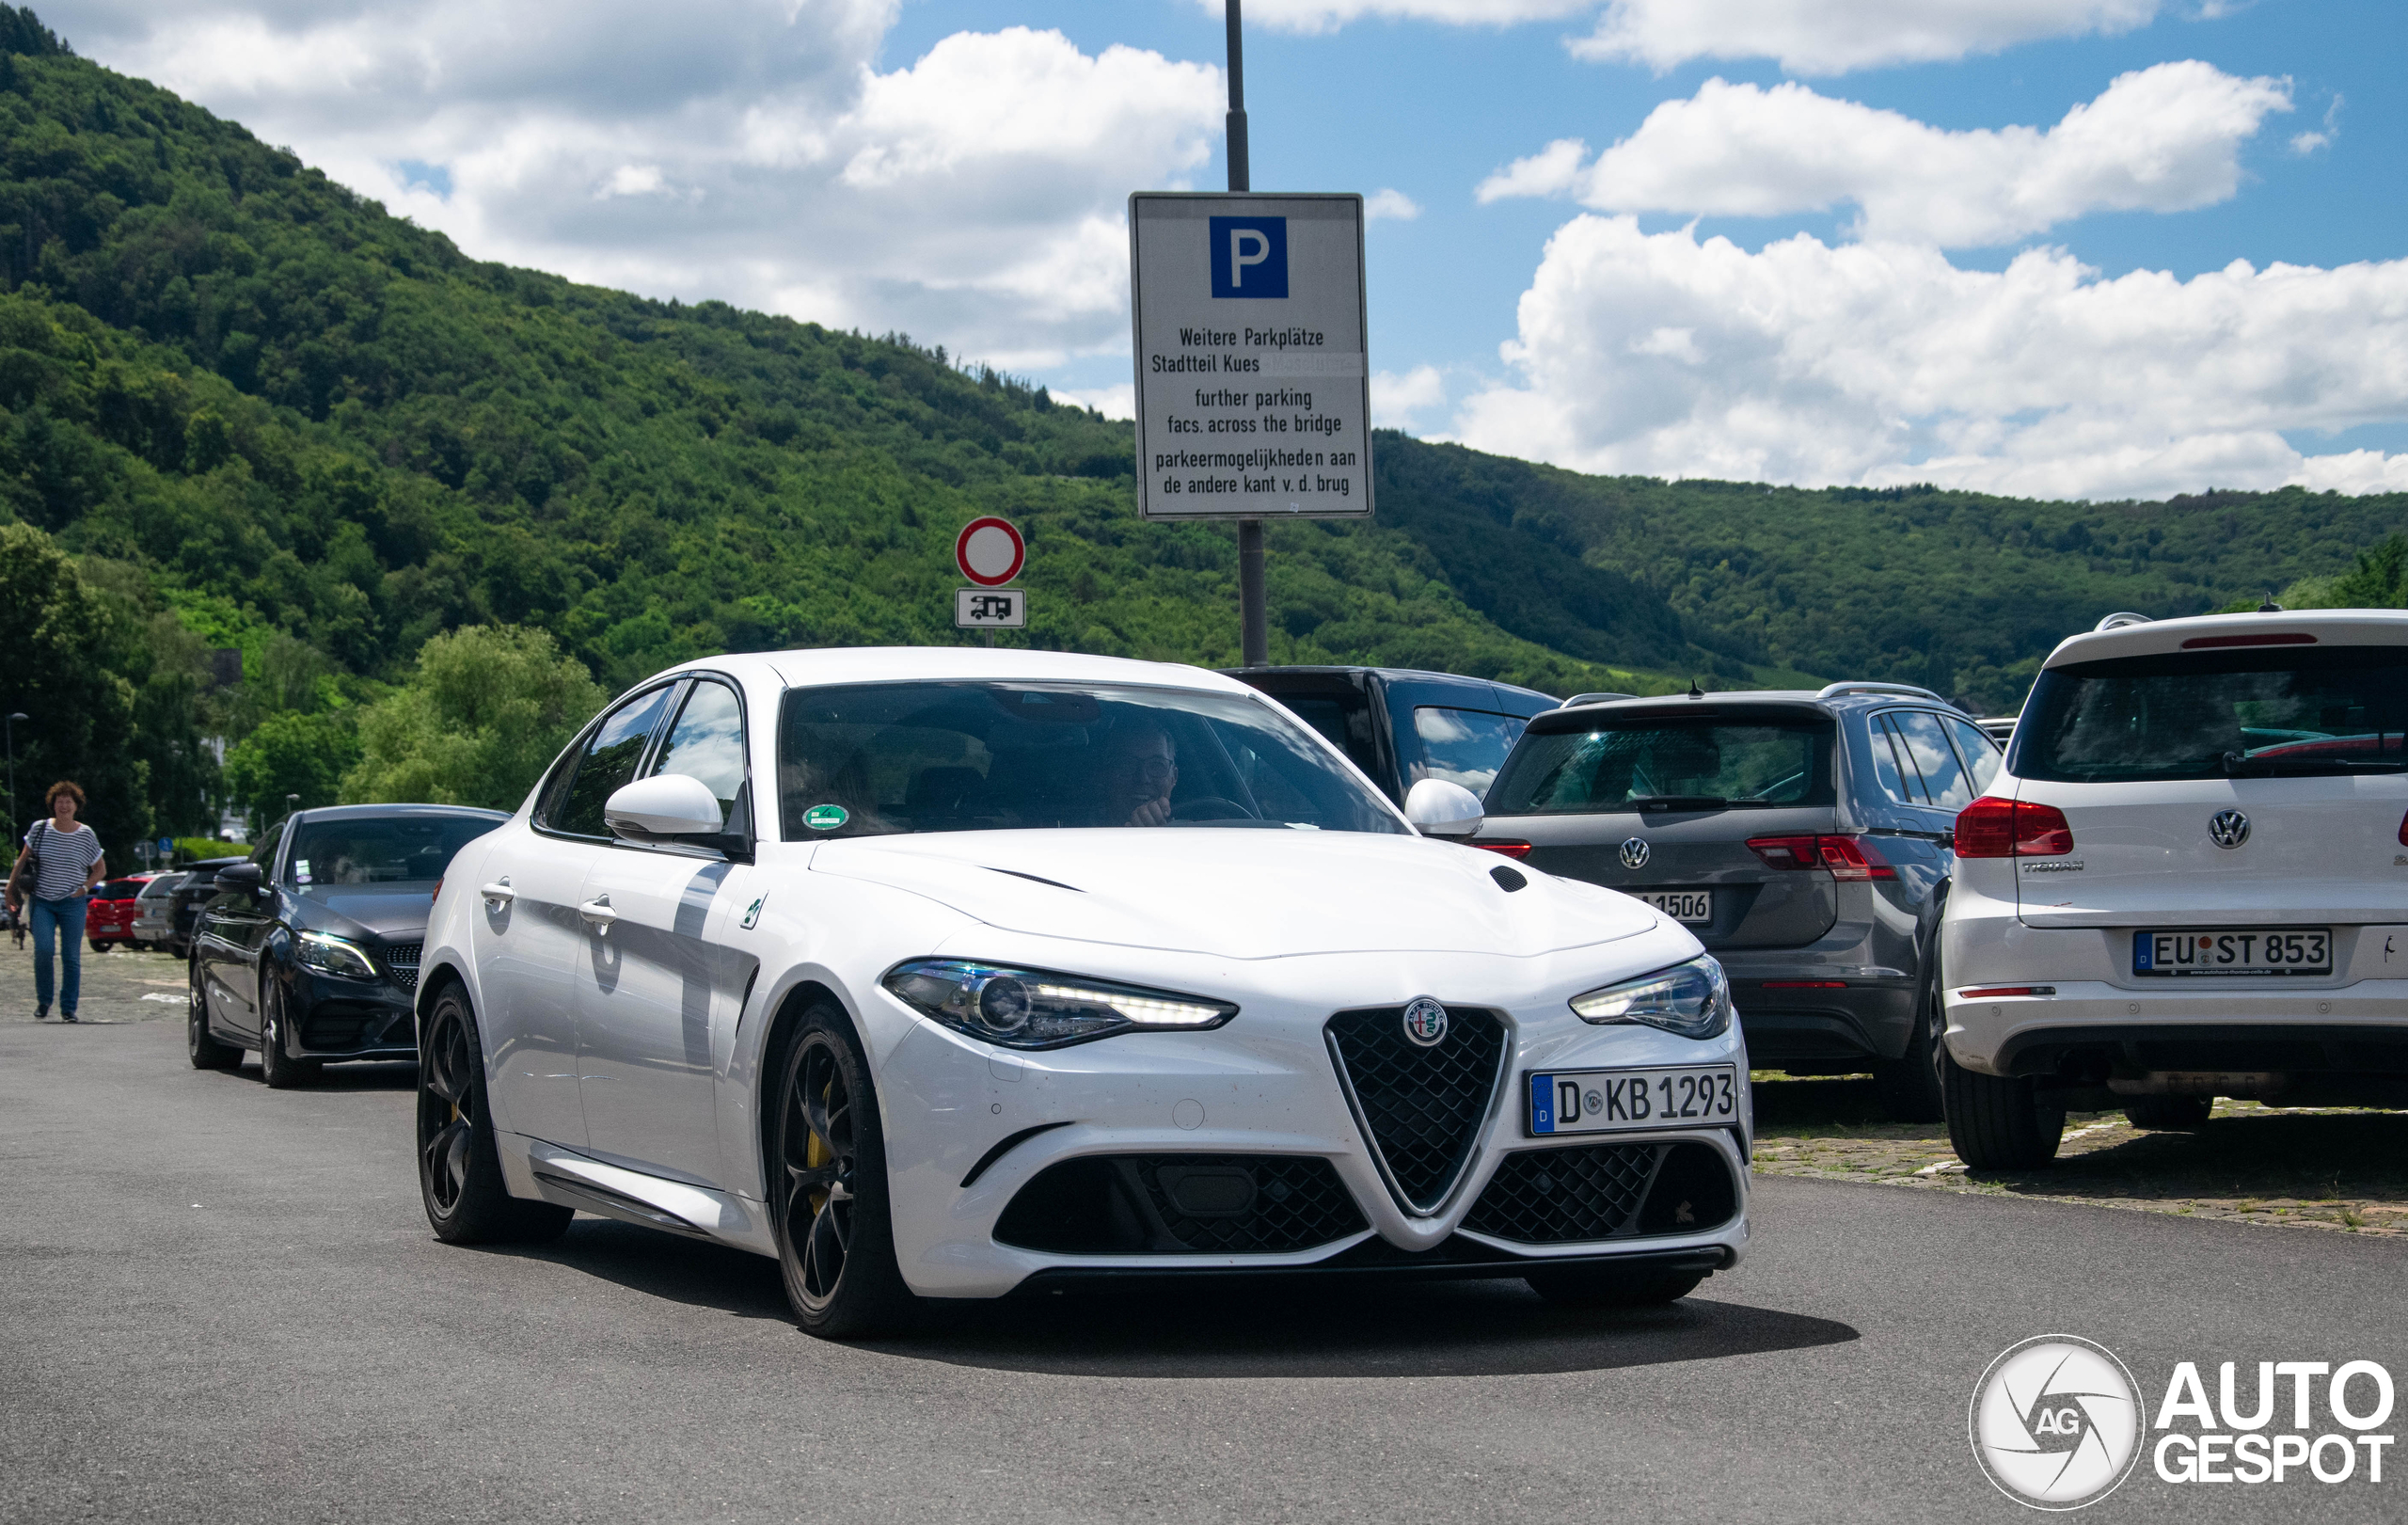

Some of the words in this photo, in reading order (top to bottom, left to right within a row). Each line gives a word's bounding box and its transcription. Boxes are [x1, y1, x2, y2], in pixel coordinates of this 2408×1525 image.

[1230, 229, 1270, 288] P
[1180, 327, 1237, 346] Weitere
[1244, 327, 1323, 351] Parkplätze
[1151, 354, 1217, 373] Stadtteil
[1223, 354, 1259, 373] Kues
[1195, 388, 1249, 407] further
[1255, 388, 1312, 411] parking
[1167, 415, 1203, 434] facs.
[1208, 419, 1257, 433] across
[1263, 413, 1288, 433] the
[1294, 413, 1341, 437] bridge
[1155, 448, 1323, 472] parkeermogelijkheden
[1330, 452, 1356, 467] aan
[1164, 475, 1181, 494] de
[1188, 474, 1238, 494] andere
[1244, 474, 1276, 493] kant
[1282, 479, 1294, 492] v.
[1299, 473, 1311, 492] d.
[1317, 473, 1350, 497] brug
[820, 807, 832, 818] 4
[2022, 861, 2083, 872] TIGUAN
[2140, 955, 2147, 963] D
[2154, 935, 2194, 965] EU
[2216, 935, 2258, 964] ST
[2265, 934, 2325, 964] 853
[1408, 1005, 1421, 1024] ALFA
[1422, 1003, 1445, 1024] ROMEO
[1558, 1080, 1580, 1123] D
[1606, 1077, 1651, 1121] KB
[1658, 1073, 1733, 1119] 1293
[1539, 1110, 1547, 1122] D
